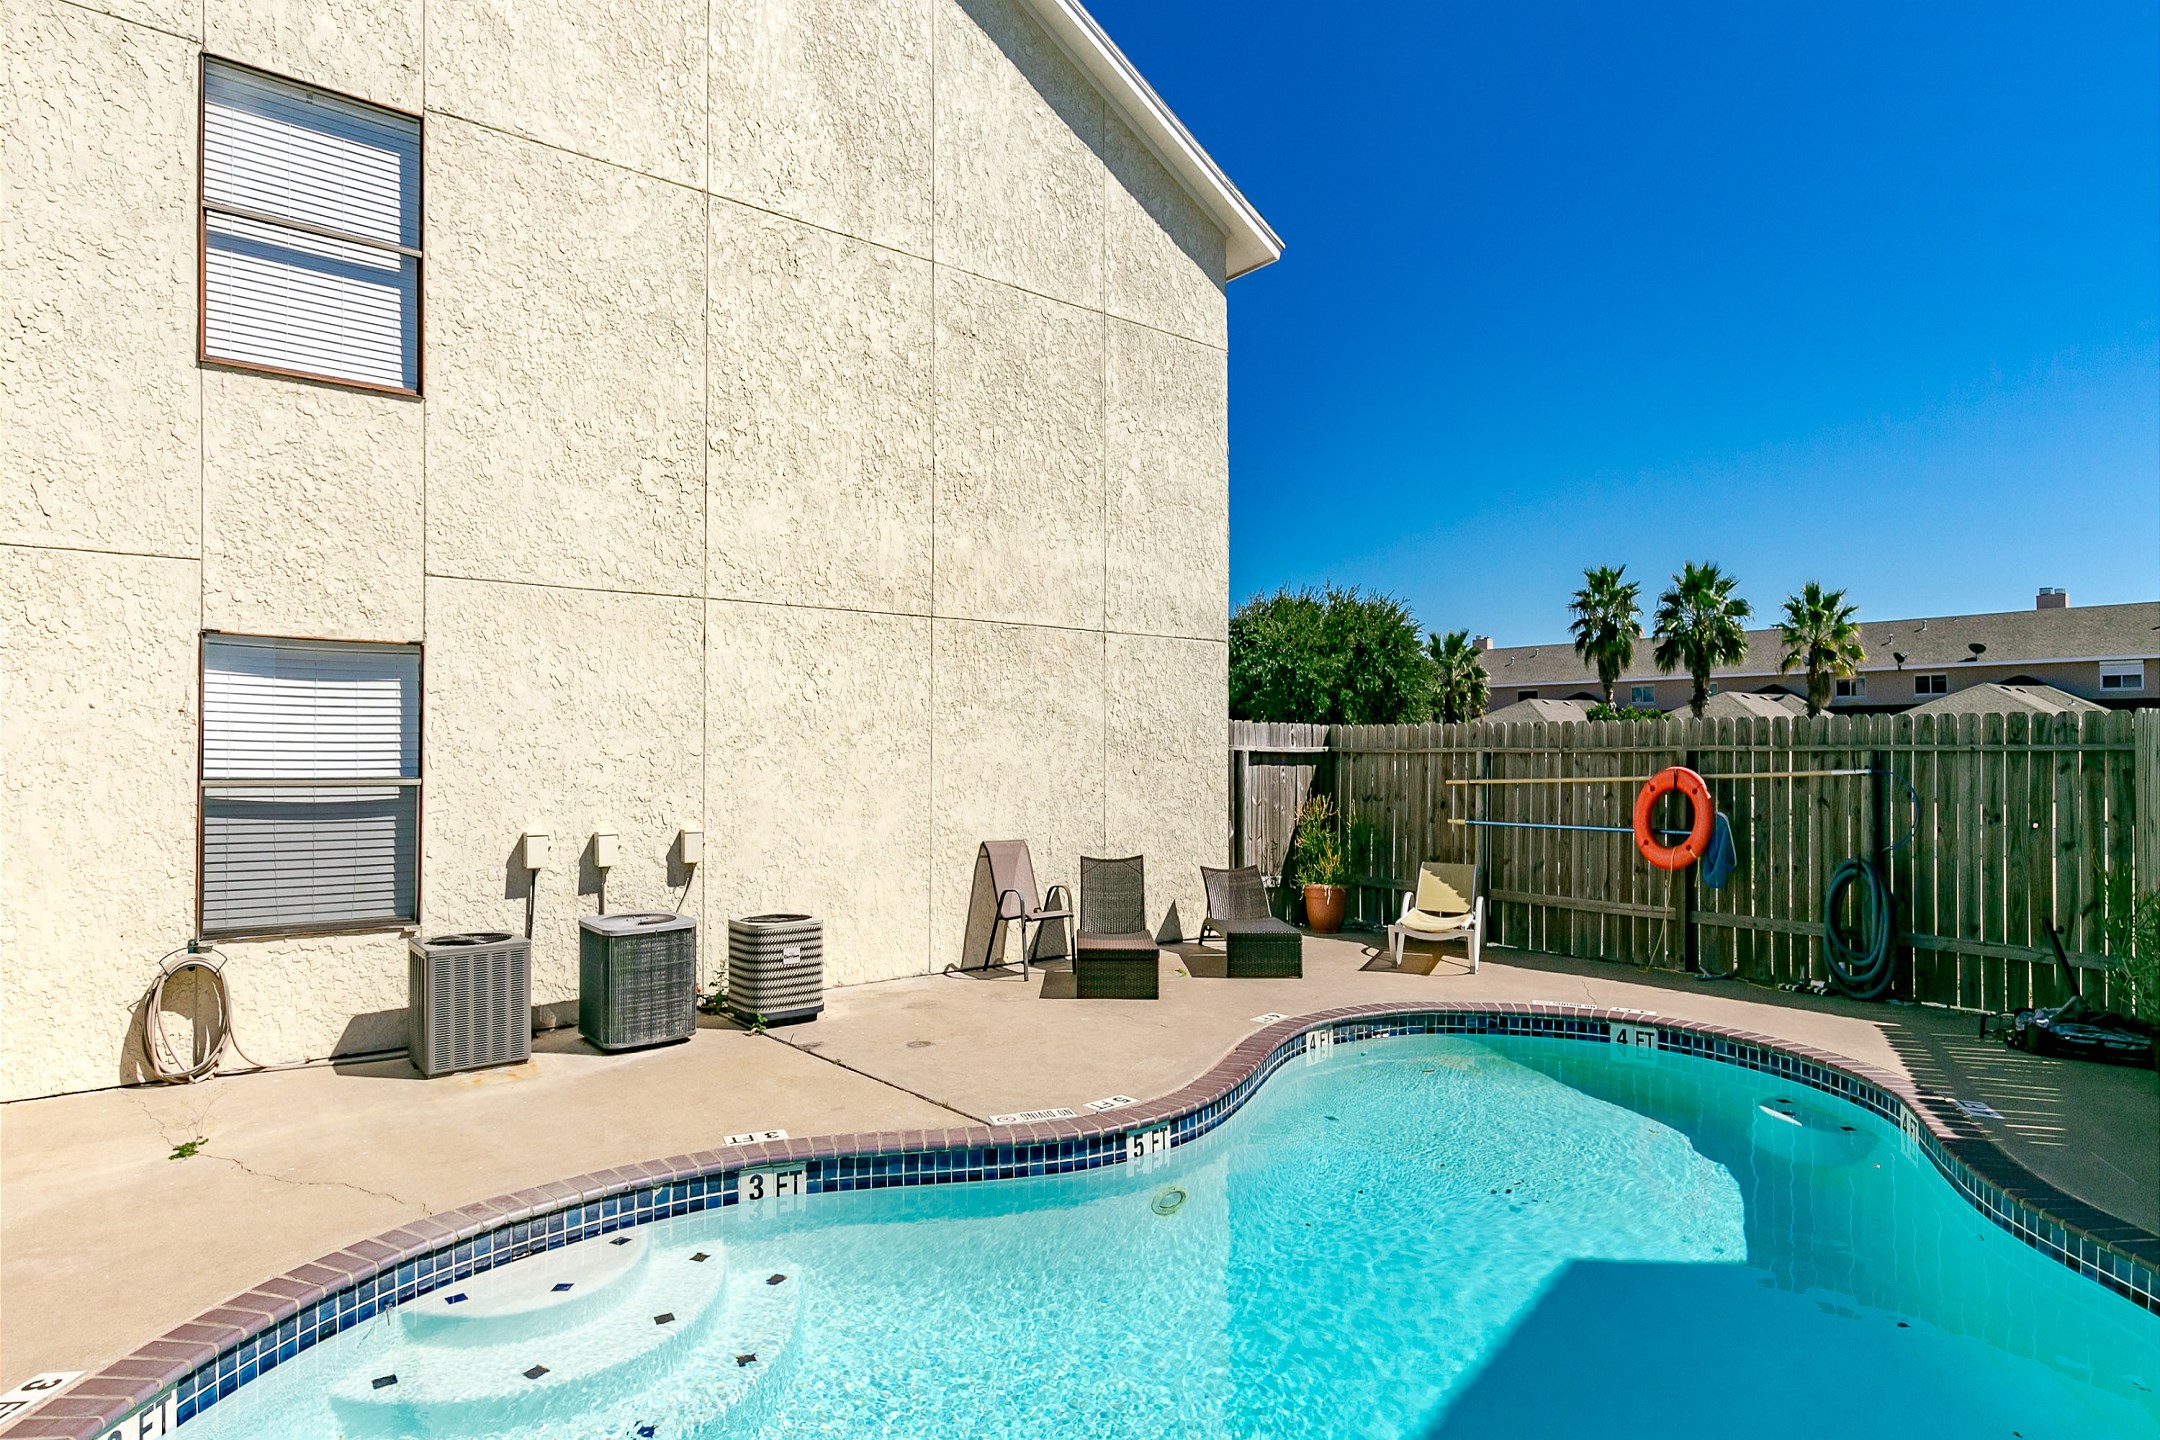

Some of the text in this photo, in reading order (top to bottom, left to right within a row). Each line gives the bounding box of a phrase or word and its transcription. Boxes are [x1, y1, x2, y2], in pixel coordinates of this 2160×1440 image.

[1309, 1033, 1317, 1050] 4
[1616, 1028, 1655, 1048] 4 FT
[1090, 1096, 1131, 1111] 5 FT
[1019, 1107, 1075, 1121] NO DIVING
[729, 1131, 781, 1145] 3 FT
[1133, 1126, 1168, 1158] 5 FT
[748, 1169, 803, 1201] 3 FT
[20, 1378, 63, 1392] 3
[139, 1391, 172, 1440] FT
